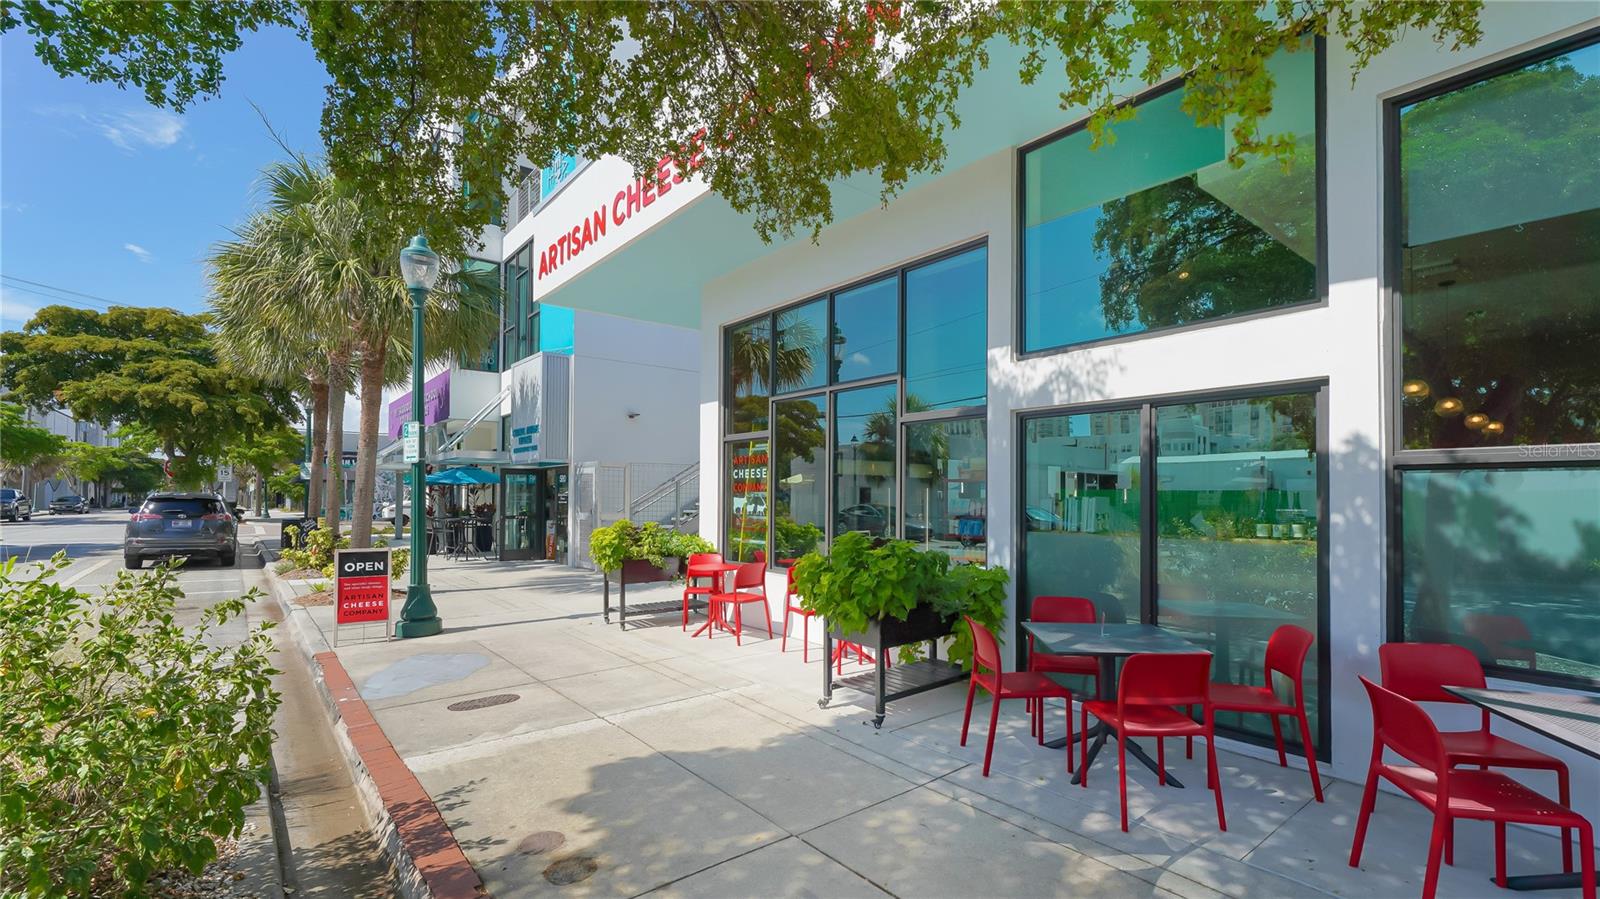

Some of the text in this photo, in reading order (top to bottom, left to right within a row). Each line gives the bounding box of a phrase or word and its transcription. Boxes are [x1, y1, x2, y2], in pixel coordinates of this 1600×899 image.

[538, 204, 606, 280] ARTISAN
[733, 454, 769, 465] ARTISAN
[733, 468, 767, 478] CHEESE
[344, 562, 384, 572] OPEN
[344, 601, 384, 609] CHEESE
[344, 609, 383, 617] COMPANY
